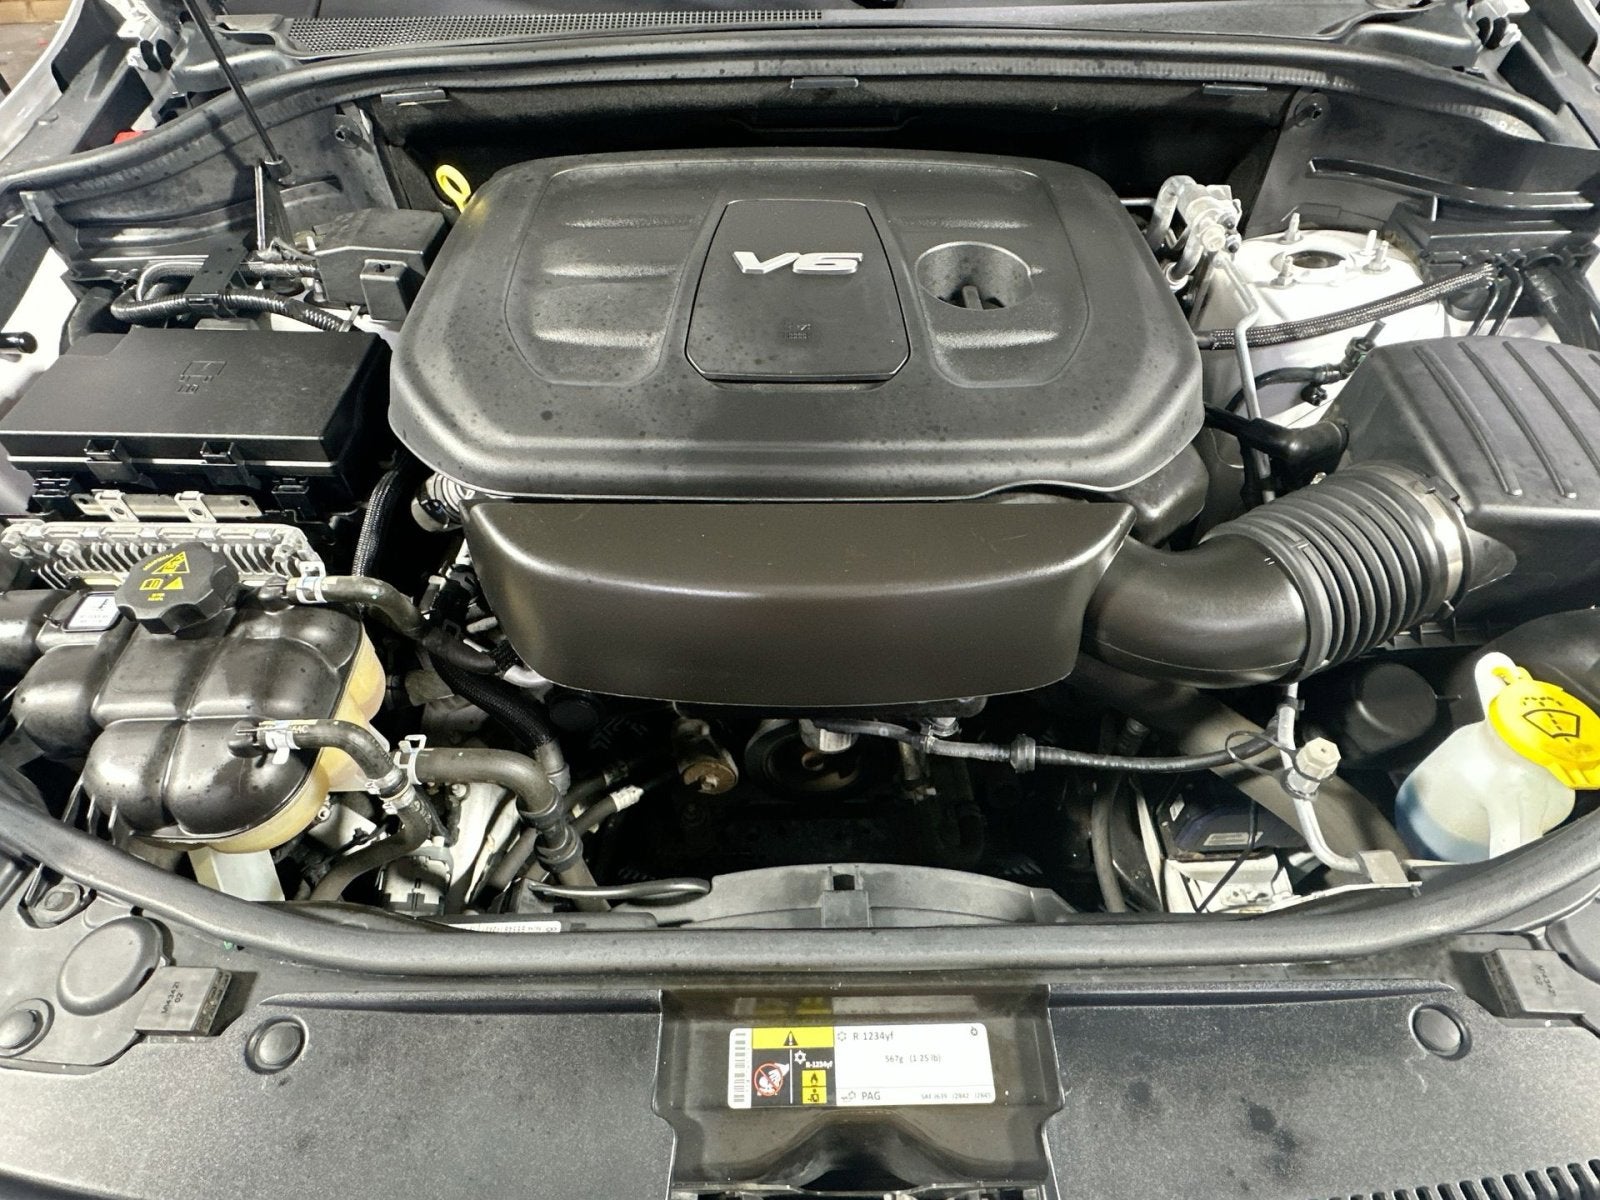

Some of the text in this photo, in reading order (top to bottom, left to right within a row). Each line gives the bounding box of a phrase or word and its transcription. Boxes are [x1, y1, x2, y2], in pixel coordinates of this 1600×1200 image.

[732, 250, 863, 275] V6
[885, 1054, 904, 1064] 567g
[861, 1091, 881, 1101] PAG
